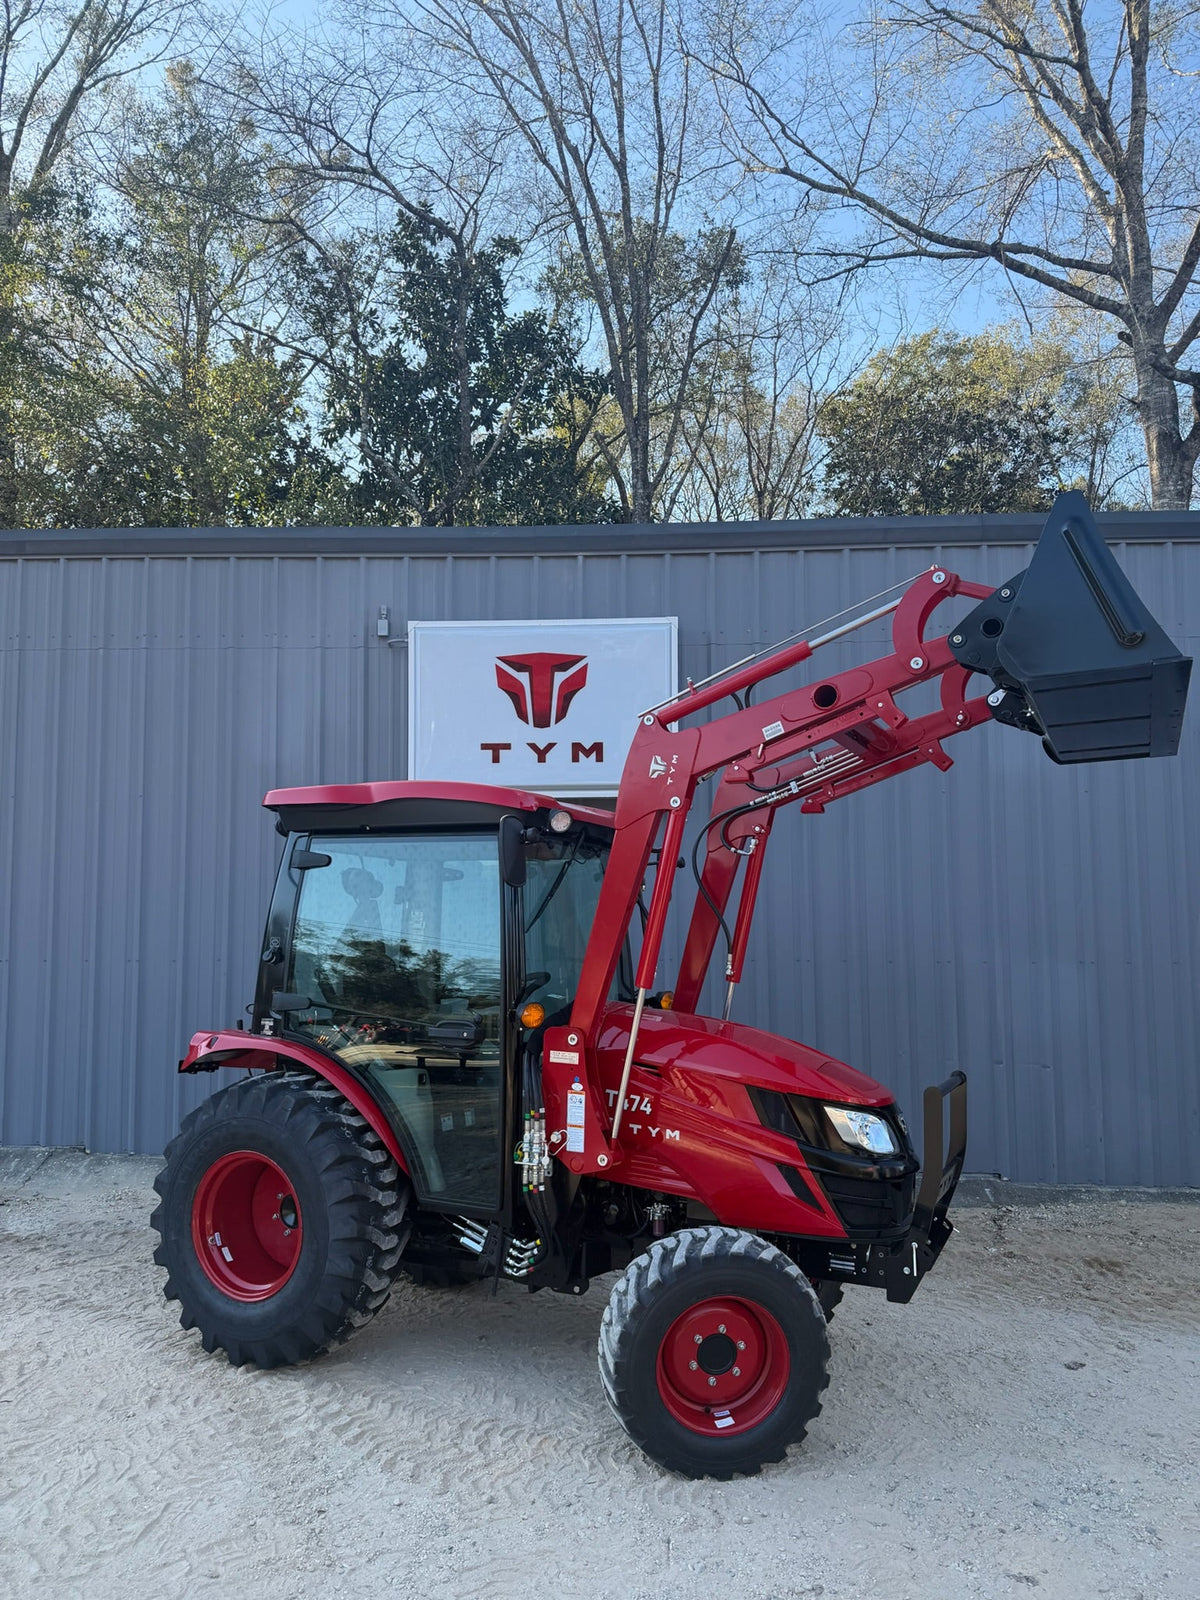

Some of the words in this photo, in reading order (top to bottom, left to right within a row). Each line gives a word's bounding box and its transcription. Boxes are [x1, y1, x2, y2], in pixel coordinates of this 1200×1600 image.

[480, 742, 604, 764] TYM
[667, 754, 679, 785] TYM
[629, 1123, 680, 1141] TYM
